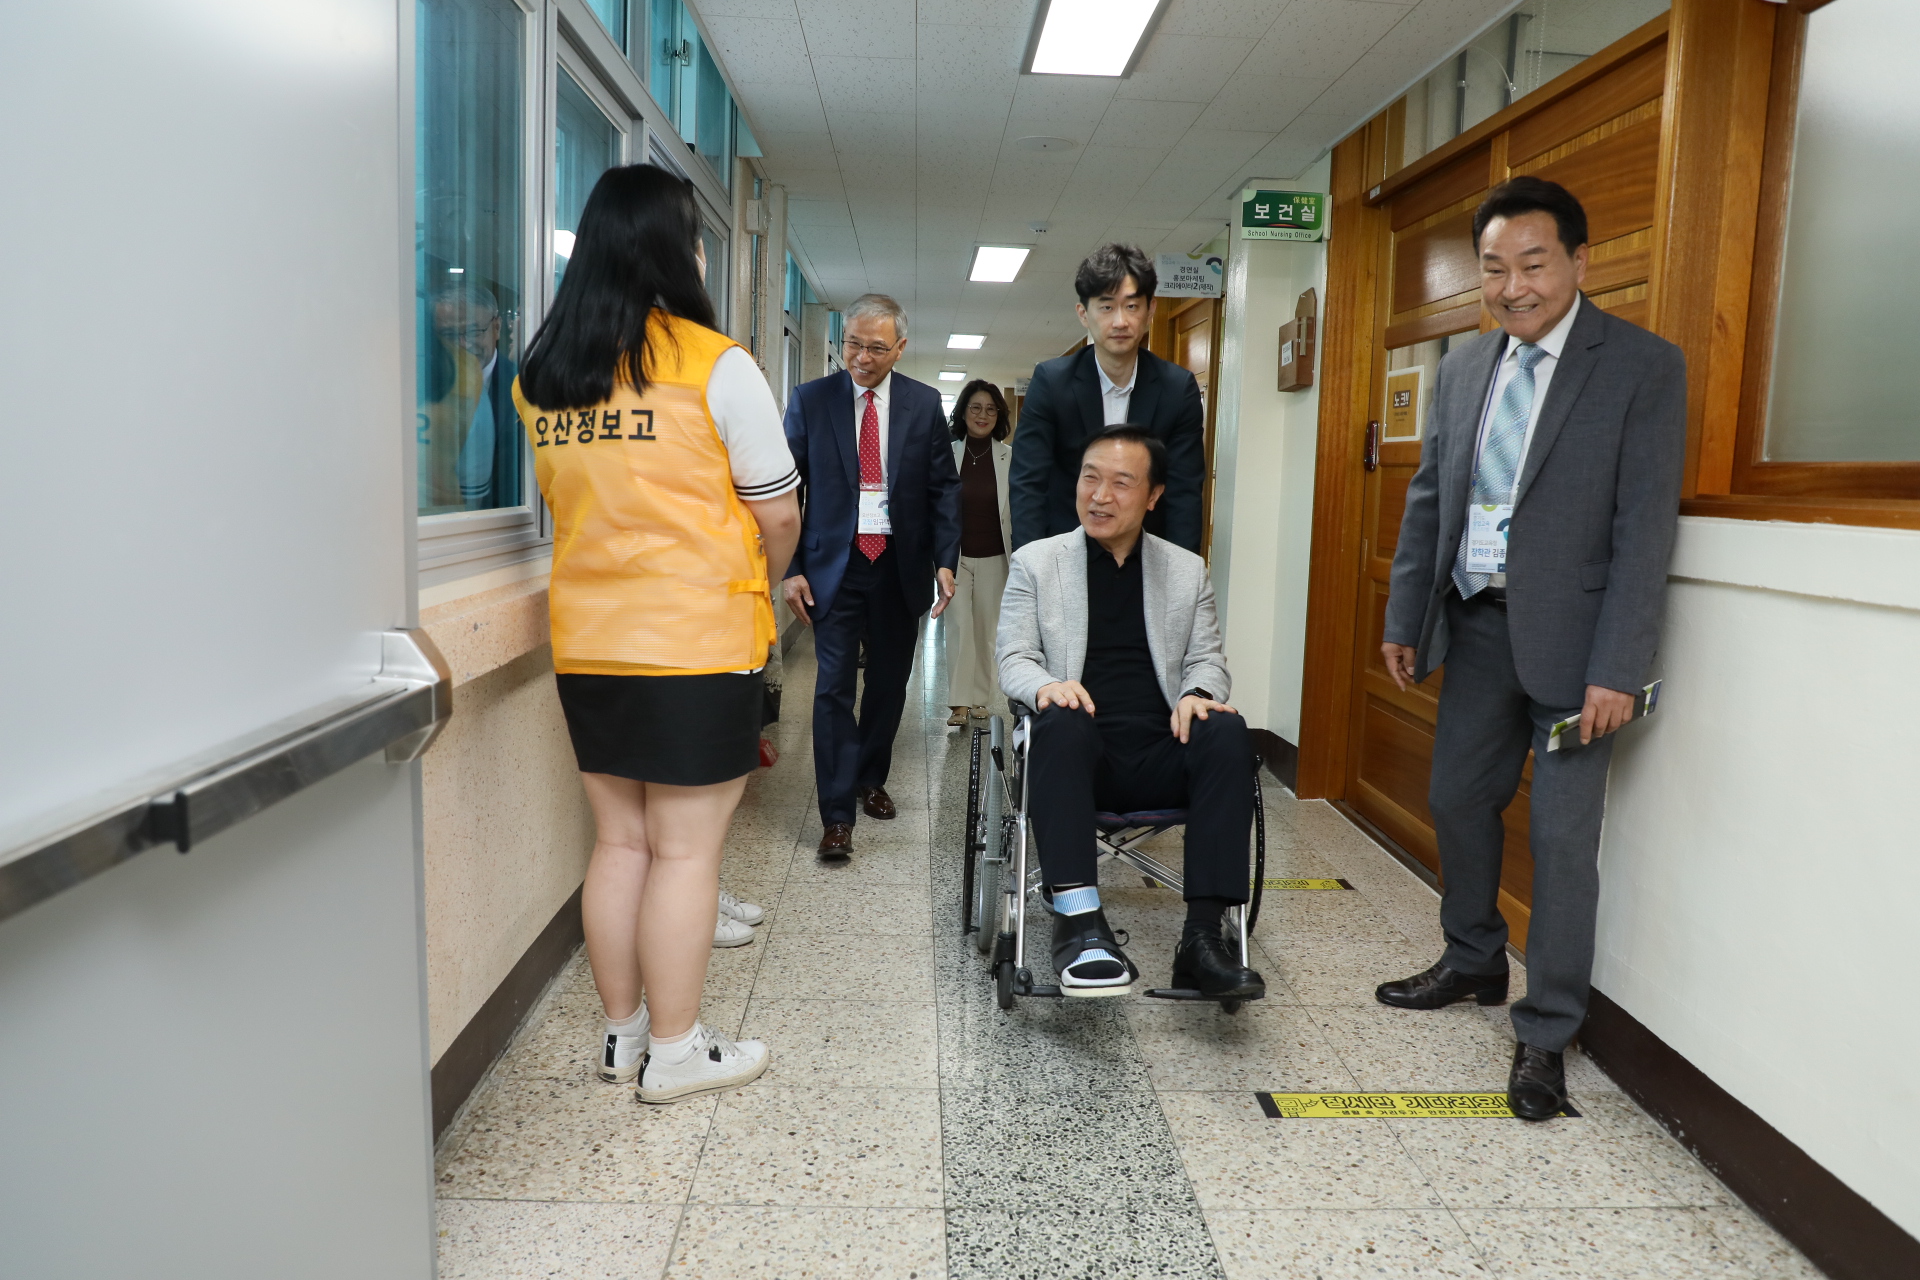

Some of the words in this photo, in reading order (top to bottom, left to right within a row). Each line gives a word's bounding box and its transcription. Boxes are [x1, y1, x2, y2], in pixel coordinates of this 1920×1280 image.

[1293, 196, 1316, 205] 保健室
[1247, 229, 1268, 237] School
[1270, 230, 1292, 239] Nursing
[1294, 231, 1312, 239] Office
[1179, 266, 1199, 274] 경연실
[1173, 274, 1205, 283] 홍보마케팅
[535, 409, 656, 447] 오산정보고
[1471, 548, 1491, 558] 장학관
[1320, 1096, 1396, 1109] 잠시만
